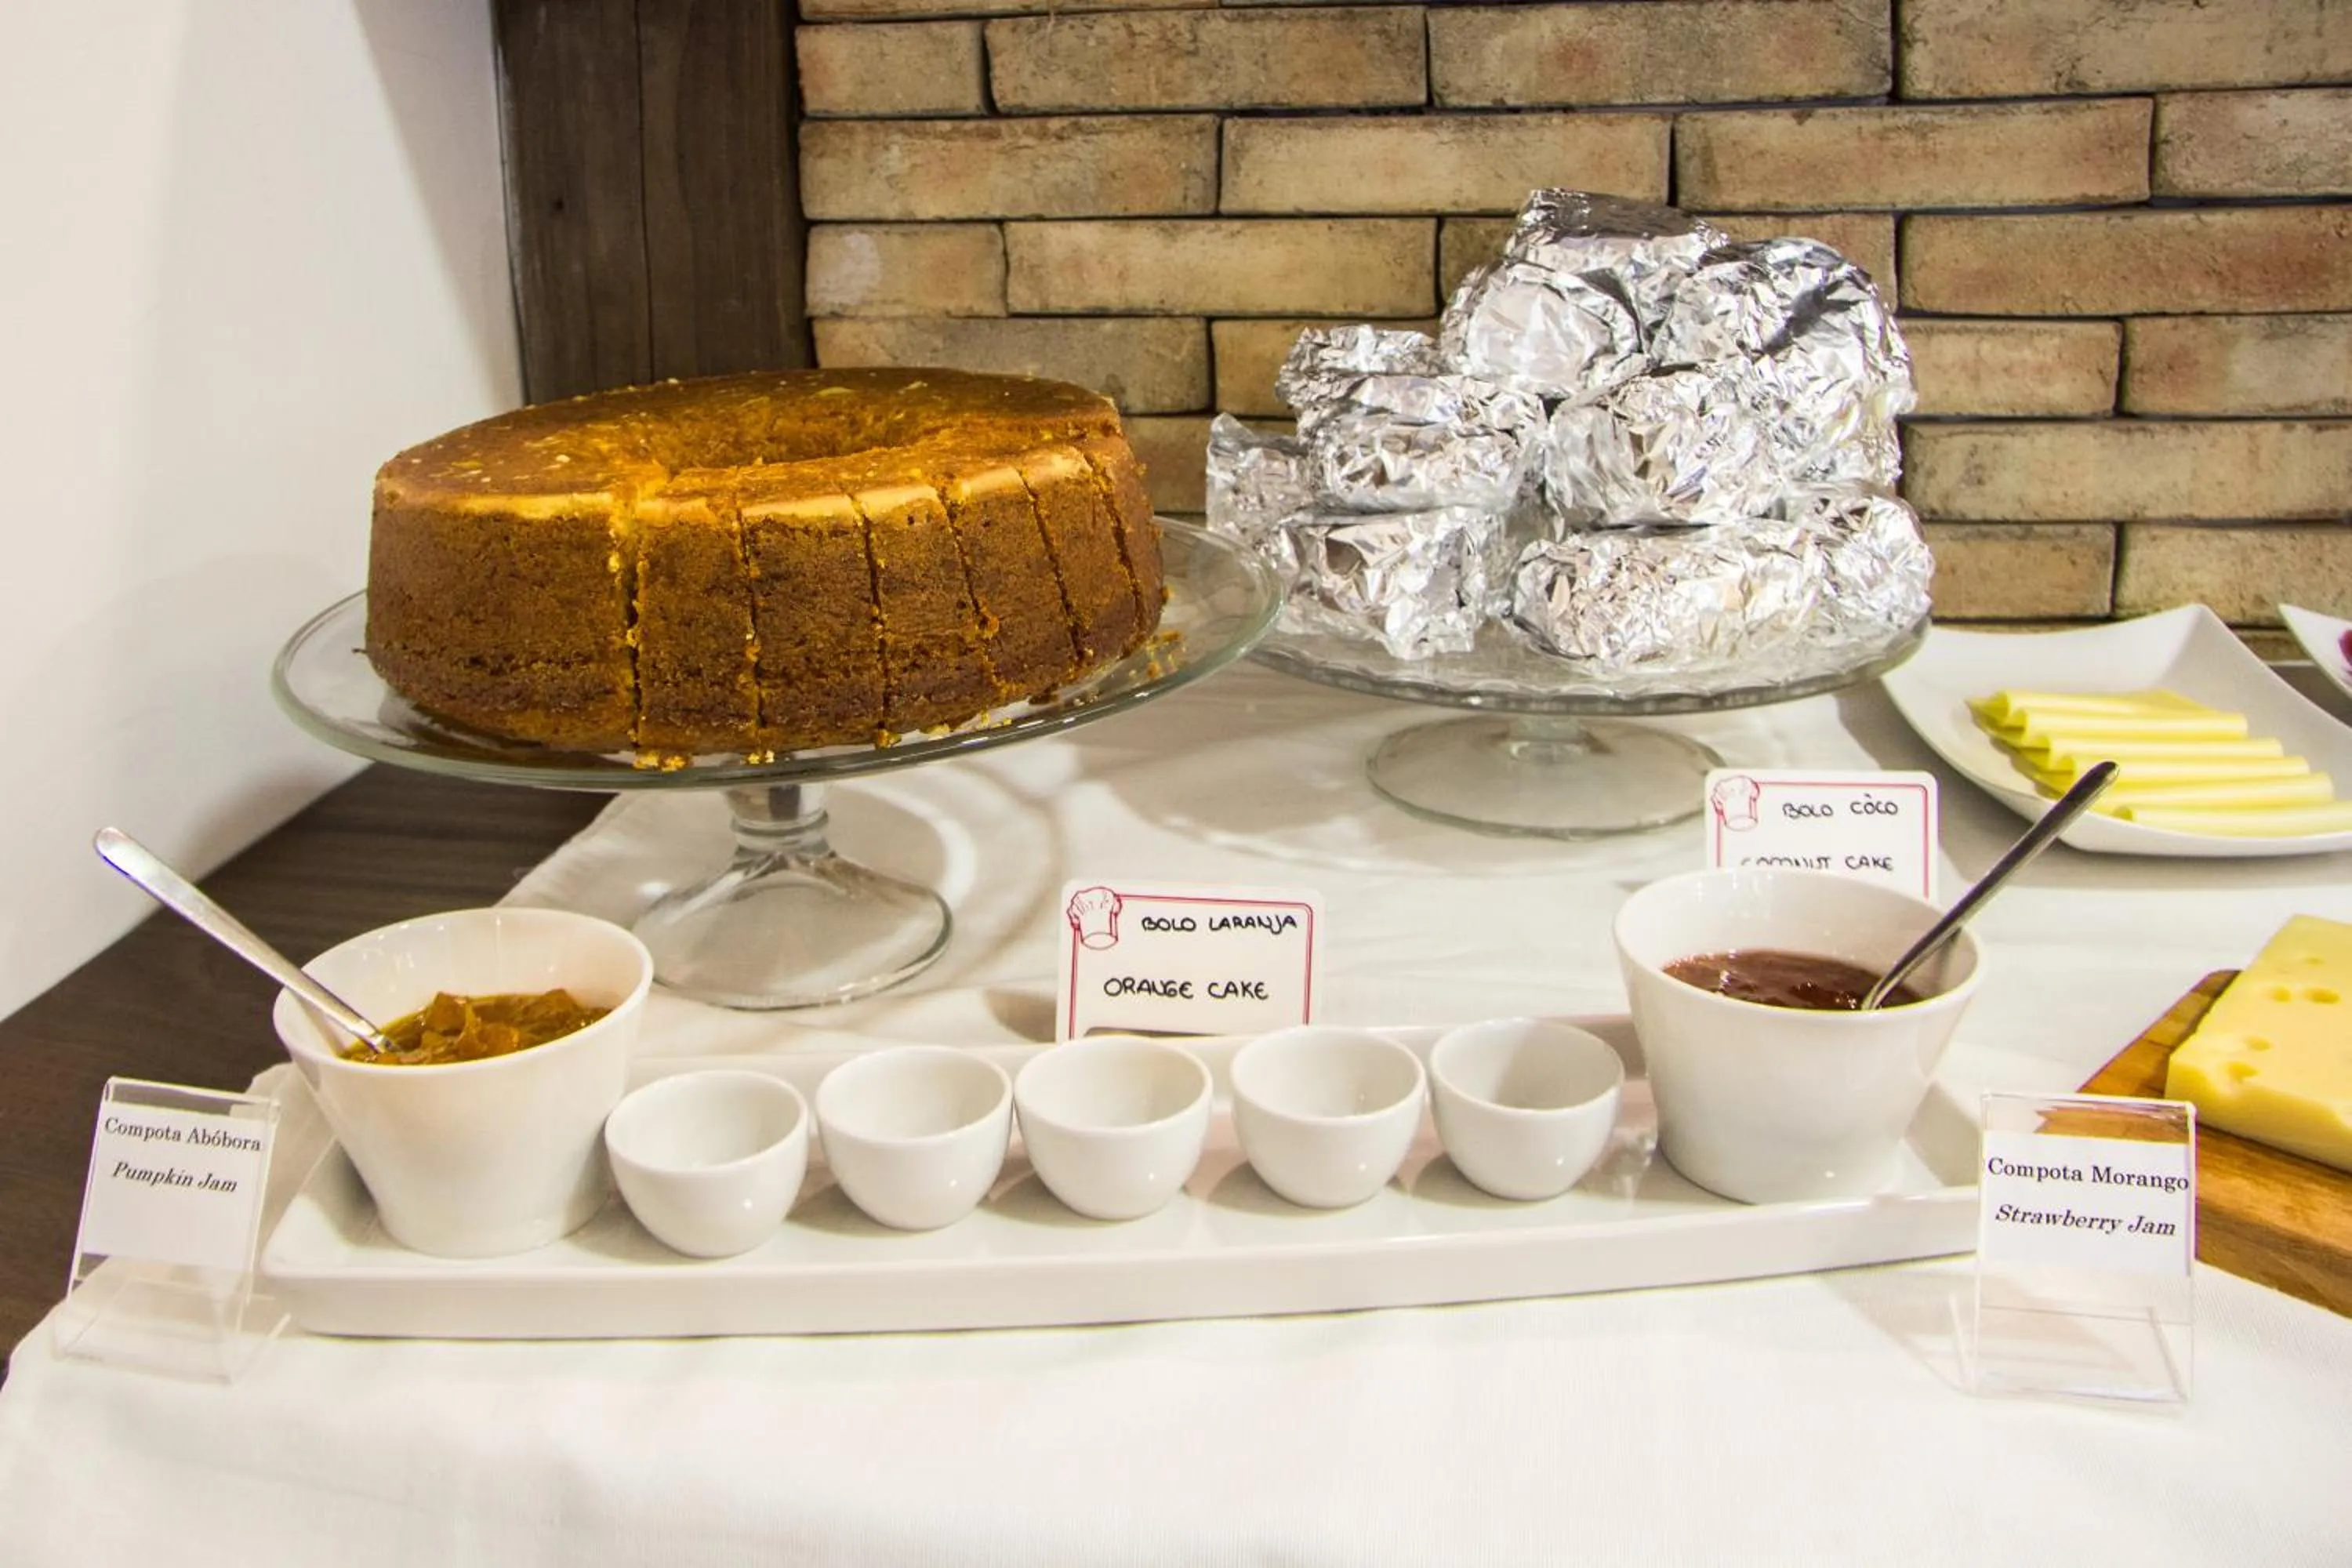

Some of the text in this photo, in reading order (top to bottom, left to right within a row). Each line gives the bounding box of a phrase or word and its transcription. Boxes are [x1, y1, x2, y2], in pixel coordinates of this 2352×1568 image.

[1781, 802, 1834, 818] BOLO
[1844, 855, 1893, 871] CAKE
[1141, 914, 1298, 936] BOLO LARANJA
[1103, 976, 1269, 1001] ORANGE CAKE
[104, 1117, 261, 1152] Compota Abóbora
[112, 1161, 238, 1192] Pumpkin Jam
[1987, 1157, 2190, 1194] Compota Morango
[1994, 1203, 2176, 1236] Strawberry Jam
